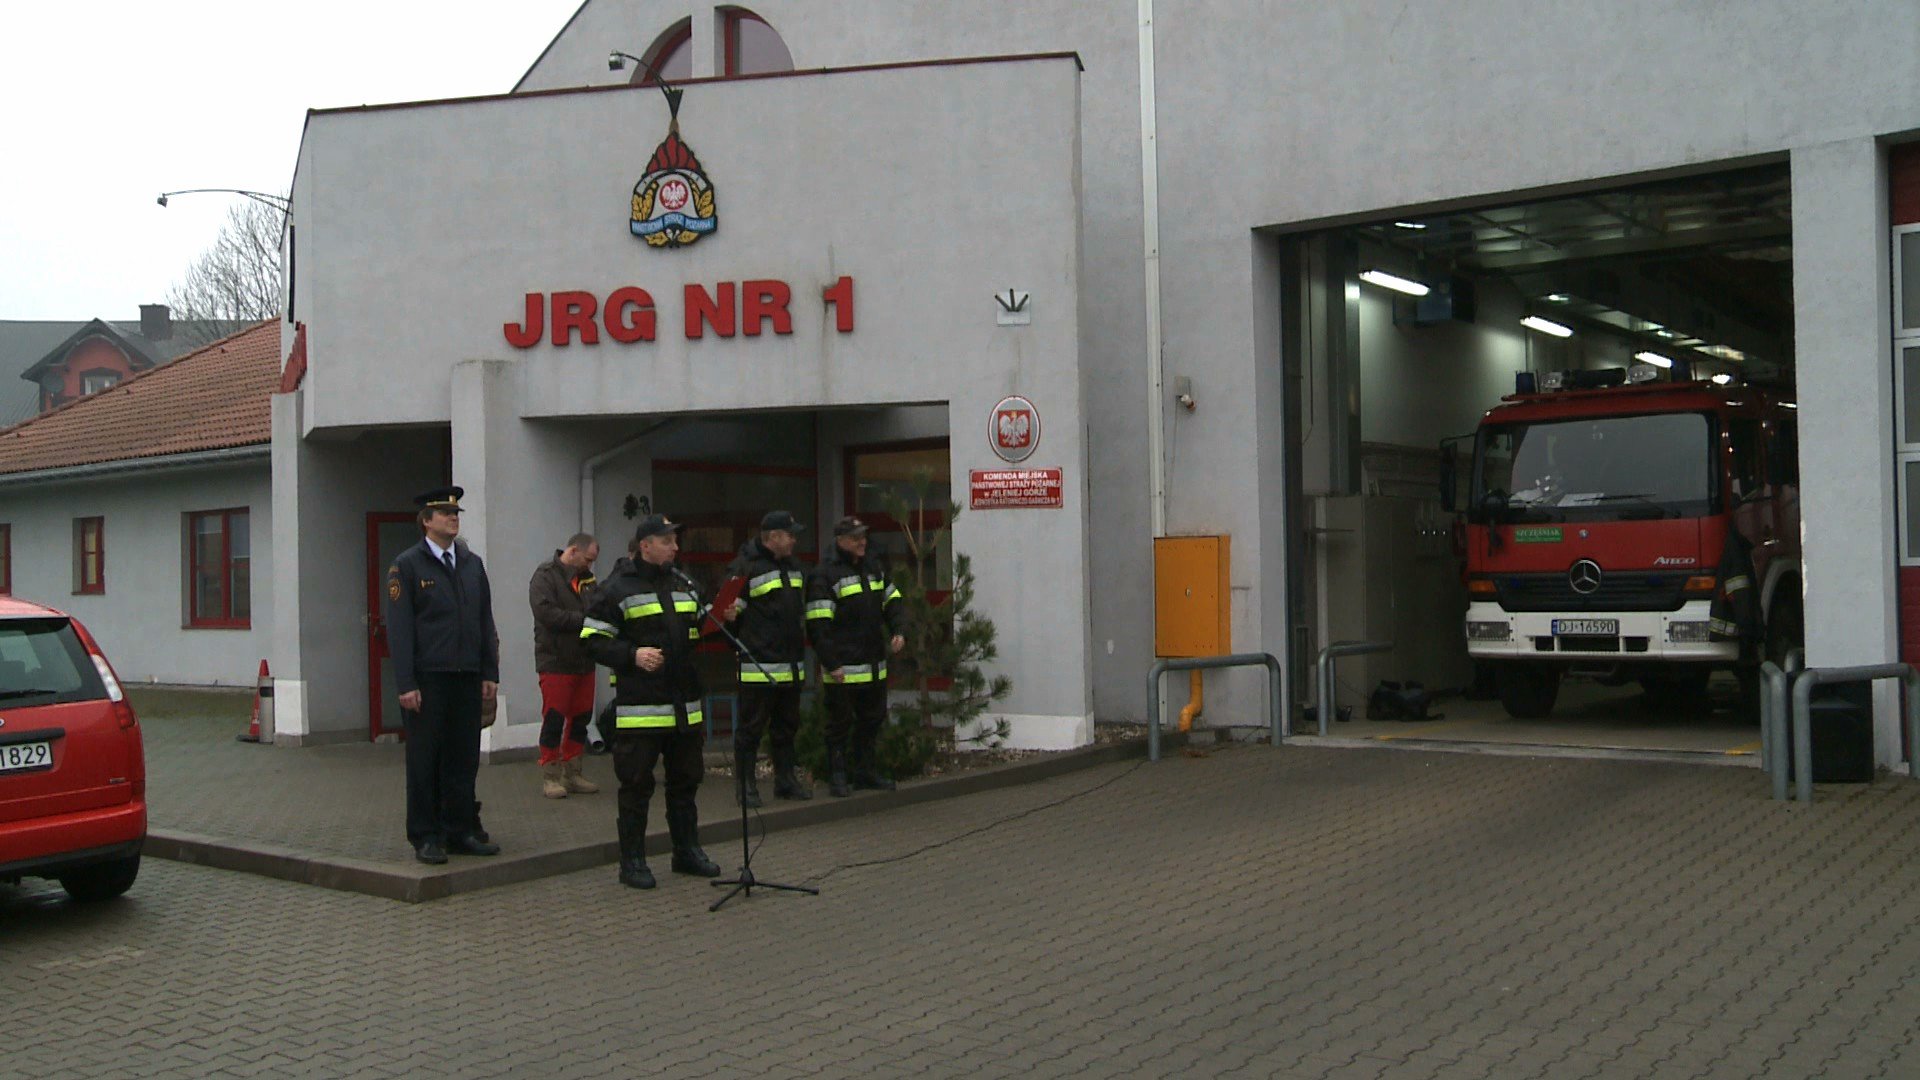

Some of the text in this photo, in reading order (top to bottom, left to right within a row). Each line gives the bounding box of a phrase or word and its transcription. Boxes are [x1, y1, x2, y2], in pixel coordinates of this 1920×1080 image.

[503, 276, 854, 348] JRG NR 1
[983, 471, 1048, 480] KOMENDA MIEJSKA
[991, 488, 1022, 497] JELENIEJ
